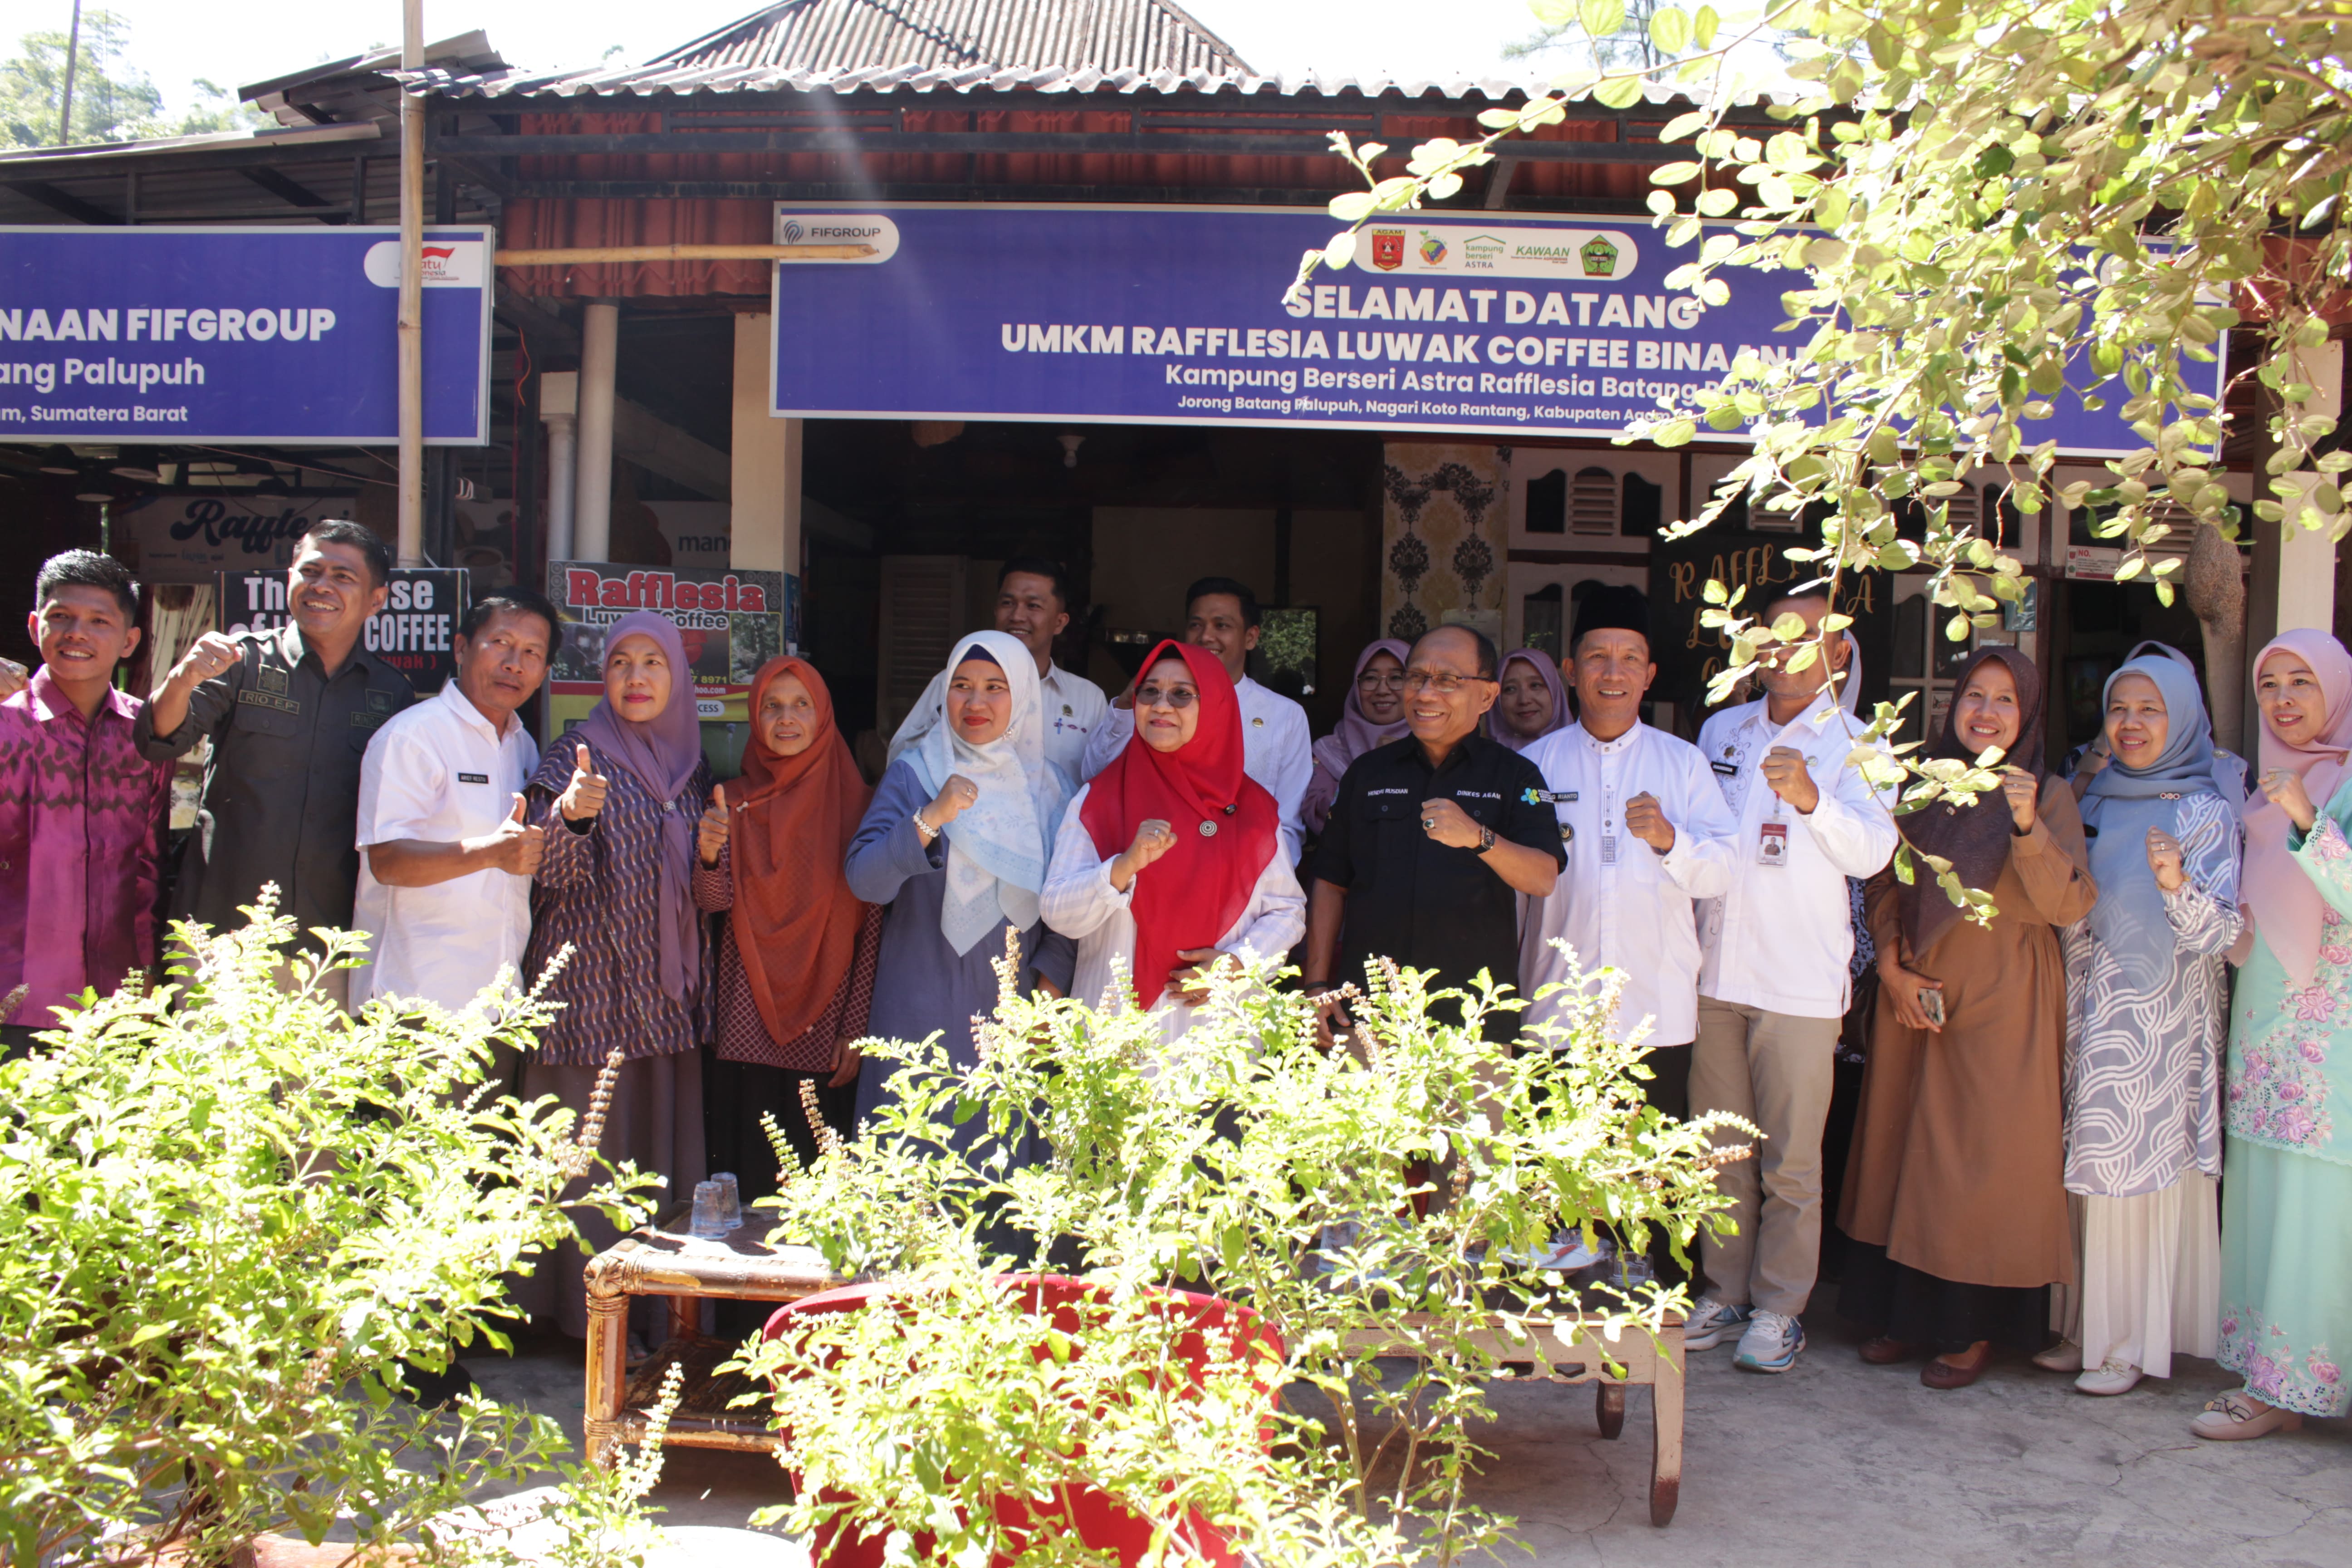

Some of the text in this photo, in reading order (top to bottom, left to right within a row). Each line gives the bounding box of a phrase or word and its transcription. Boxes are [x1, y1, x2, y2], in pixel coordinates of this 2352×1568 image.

[811, 227, 881, 237] FIFGROUP
[1465, 244, 1504, 254] kampung
[1465, 251, 1493, 260] berseri
[1515, 245, 1570, 257] KAWAAN
[1285, 285, 1700, 330] SELAMAT DATANG
[127, 308, 336, 341] FIFGROUP
[1001, 323, 1124, 354] UMKM
[1132, 326, 1331, 359] RAFFLESIA
[1338, 331, 1480, 363] LUWAK
[1487, 335, 1629, 368] COFFEE
[64, 357, 205, 393] Palupuh
[1166, 364, 1297, 394] Kampung
[1303, 368, 1396, 390] Berseri
[1401, 370, 1474, 393] Astra
[1480, 372, 1595, 397] Rafflesia
[1601, 377, 1699, 407] Batang
[30, 406, 128, 421] Sumatera
[133, 406, 188, 421] Barat
[1177, 395, 1232, 413] Jorong
[1235, 397, 1291, 413] Batang
[1294, 398, 1362, 416] Palupuh,
[1366, 400, 1418, 417] Nagari
[1421, 402, 1457, 416] Koto
[1460, 403, 1531, 421] Rantang,
[1534, 405, 1620, 422] Kabupaten
[2078, 549, 2091, 557] NO.
[567, 569, 767, 612] Rafflesia
[364, 614, 451, 652] COFFEE
[701, 676, 727, 684] 8971
[245, 693, 269, 704] RIO
